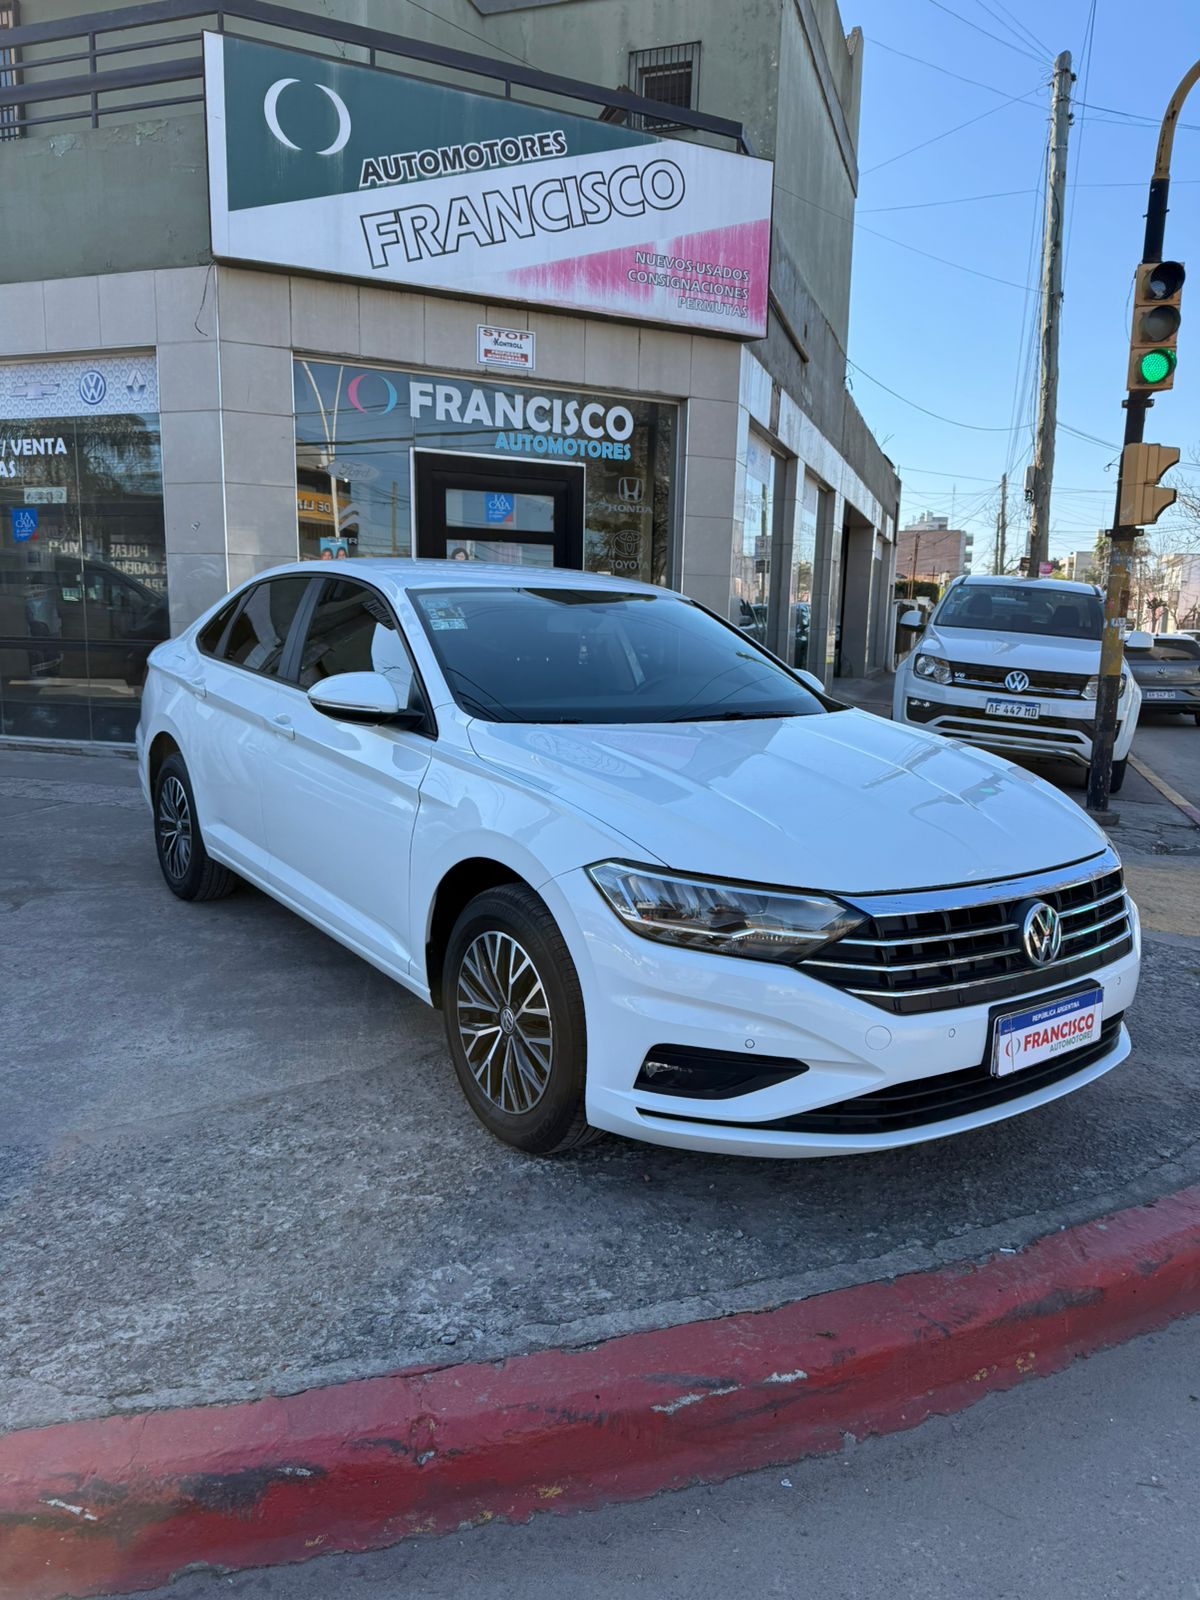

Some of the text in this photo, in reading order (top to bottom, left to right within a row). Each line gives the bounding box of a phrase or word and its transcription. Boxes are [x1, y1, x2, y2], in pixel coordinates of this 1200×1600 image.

[360, 131, 567, 188] AUTOMOTORES
[360, 159, 686, 269] FRANCISCO
[627, 269, 749, 300] CONSIGNACIONES
[678, 296, 749, 318] PERMUTAS
[483, 329, 529, 340] STOP
[410, 381, 634, 441] FRANCISCO
[11, 437, 68, 456] VENTA
[494, 433, 632, 461] AUTOMOTORES
[608, 504, 654, 514] HONDA
[609, 560, 650, 570] TOYOTA
[988, 703, 1038, 717] AF 447 MD
[1057, 1001, 1080, 1014] ARGENTINA
[1023, 1013, 1095, 1052] FRANCISCO
